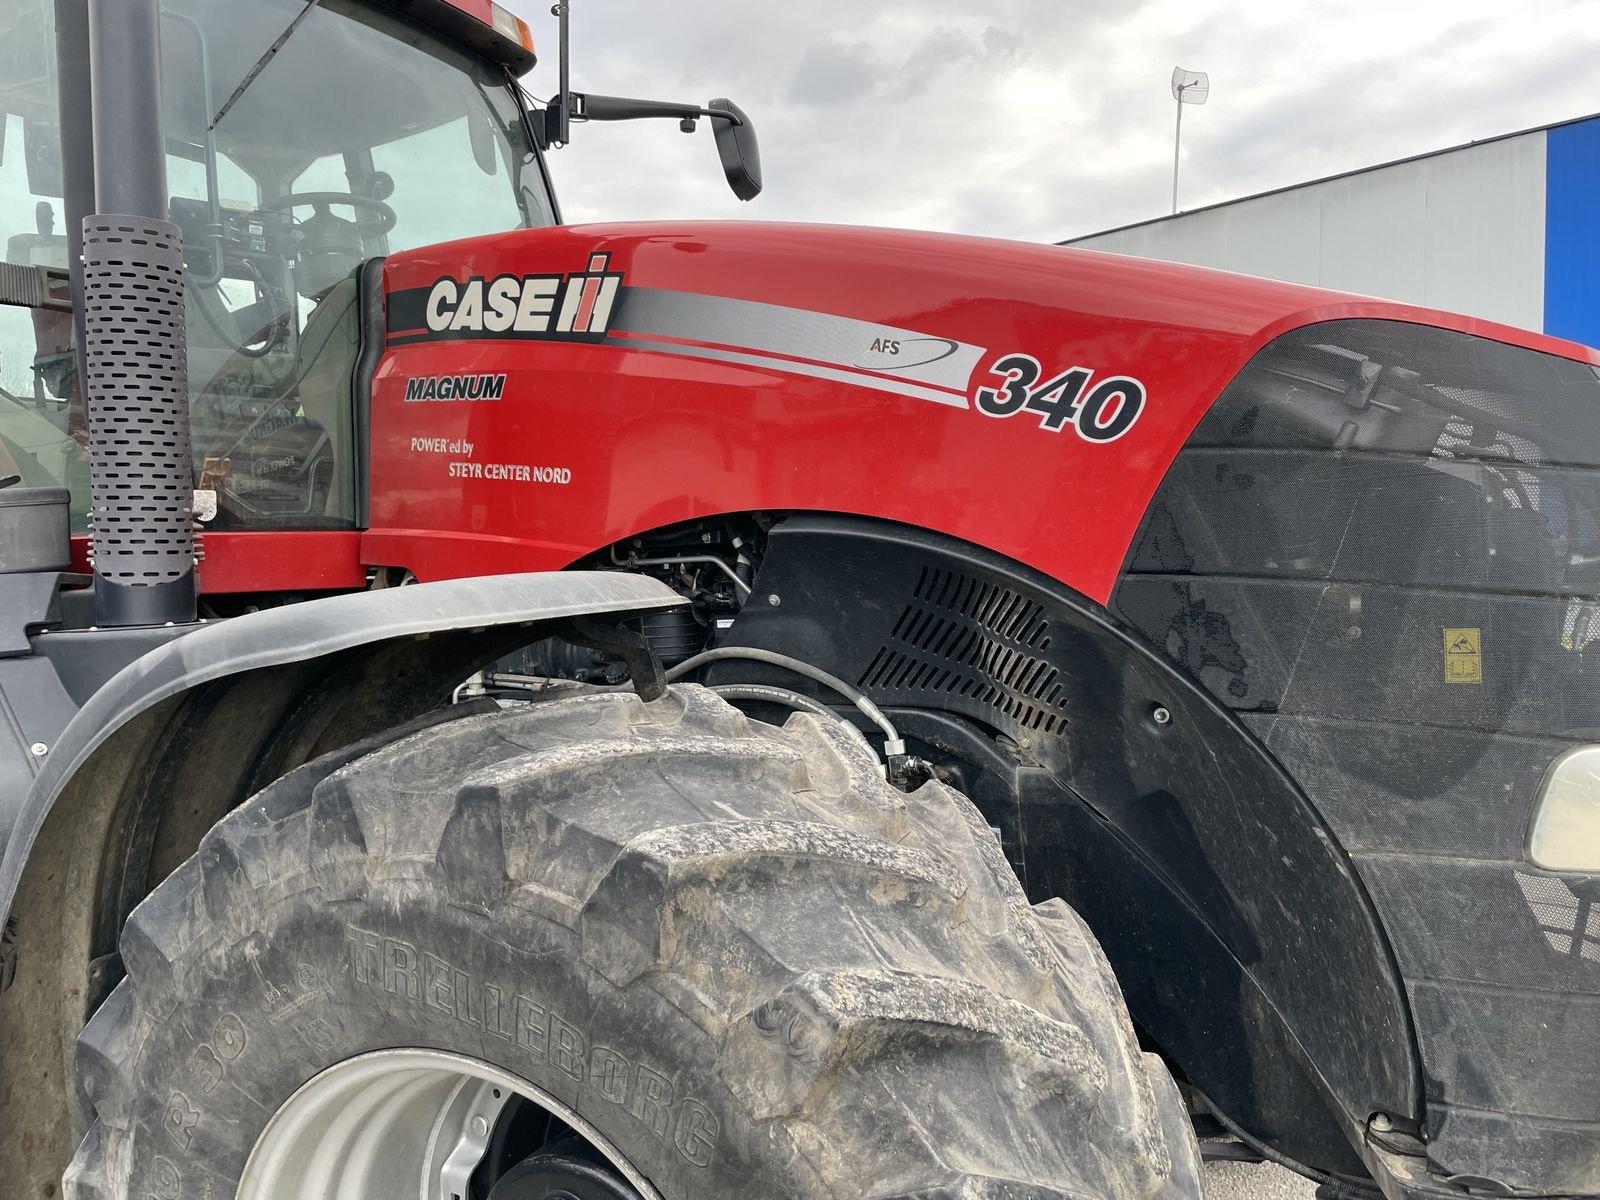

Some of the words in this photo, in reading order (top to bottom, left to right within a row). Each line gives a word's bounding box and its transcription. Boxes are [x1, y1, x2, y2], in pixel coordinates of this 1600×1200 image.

[426, 277, 560, 332] CASE
[870, 337, 900, 355] AFS
[405, 374, 507, 402] MAGNUM
[975, 353, 1146, 443] 340
[462, 440, 474, 458] by
[449, 462, 482, 478] STEYR
[484, 463, 530, 482] CENTER
[533, 466, 572, 485] NORD
[190, 1012, 247, 1094] 30
[345, 924, 721, 1168] TRELLEBORG
